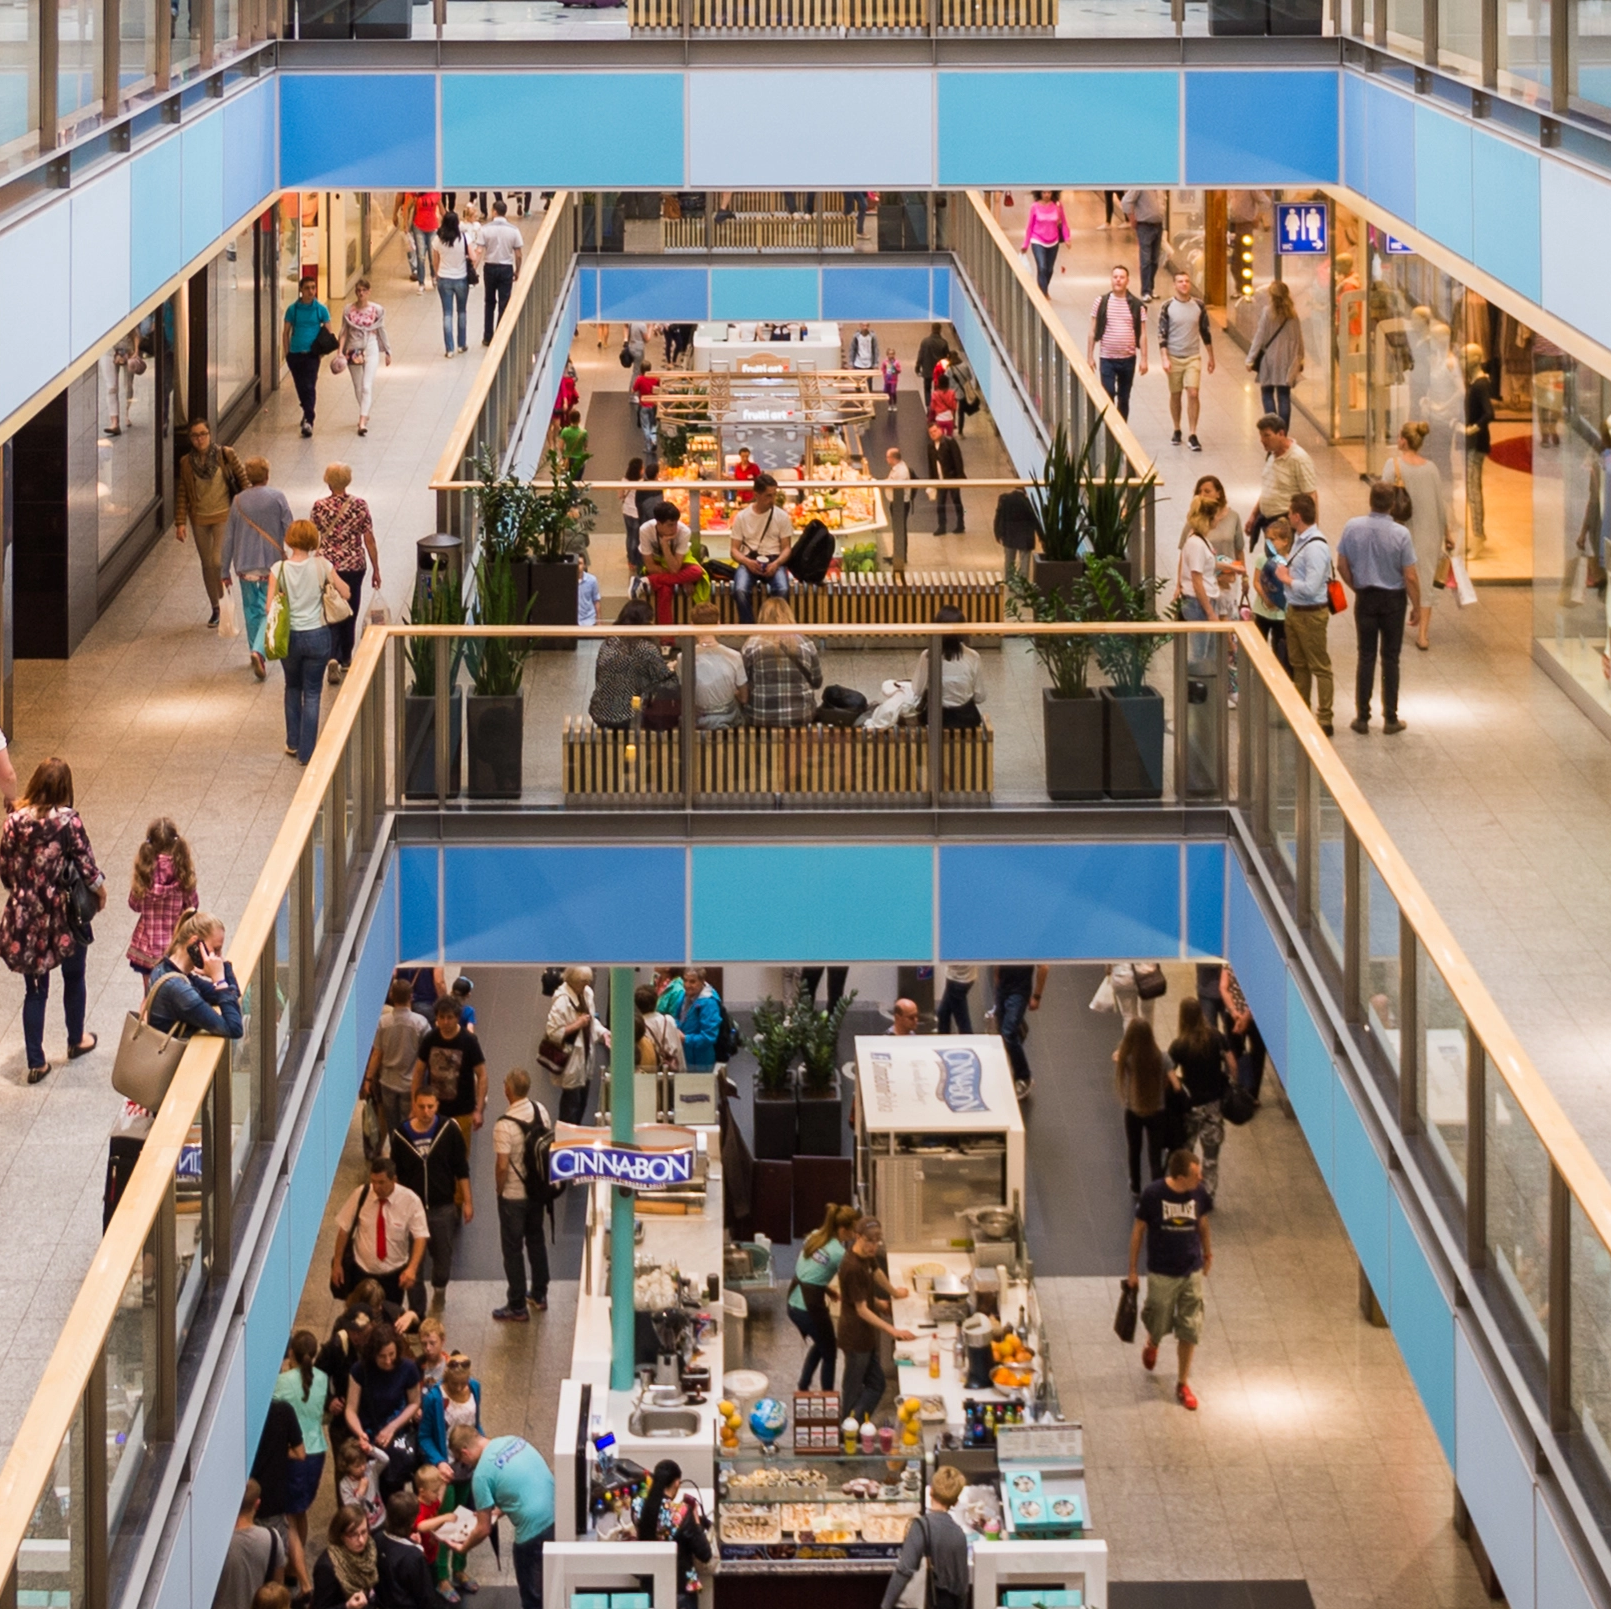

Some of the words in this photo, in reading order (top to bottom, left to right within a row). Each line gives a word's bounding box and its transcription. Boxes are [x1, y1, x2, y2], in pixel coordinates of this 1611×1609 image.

[1282, 243, 1294, 251] WC
[742, 363, 767, 373] frutti
[768, 364, 784, 373] art
[743, 408, 769, 420] frutti
[771, 409, 787, 420] art
[552, 1149, 690, 1181] CINNABON
